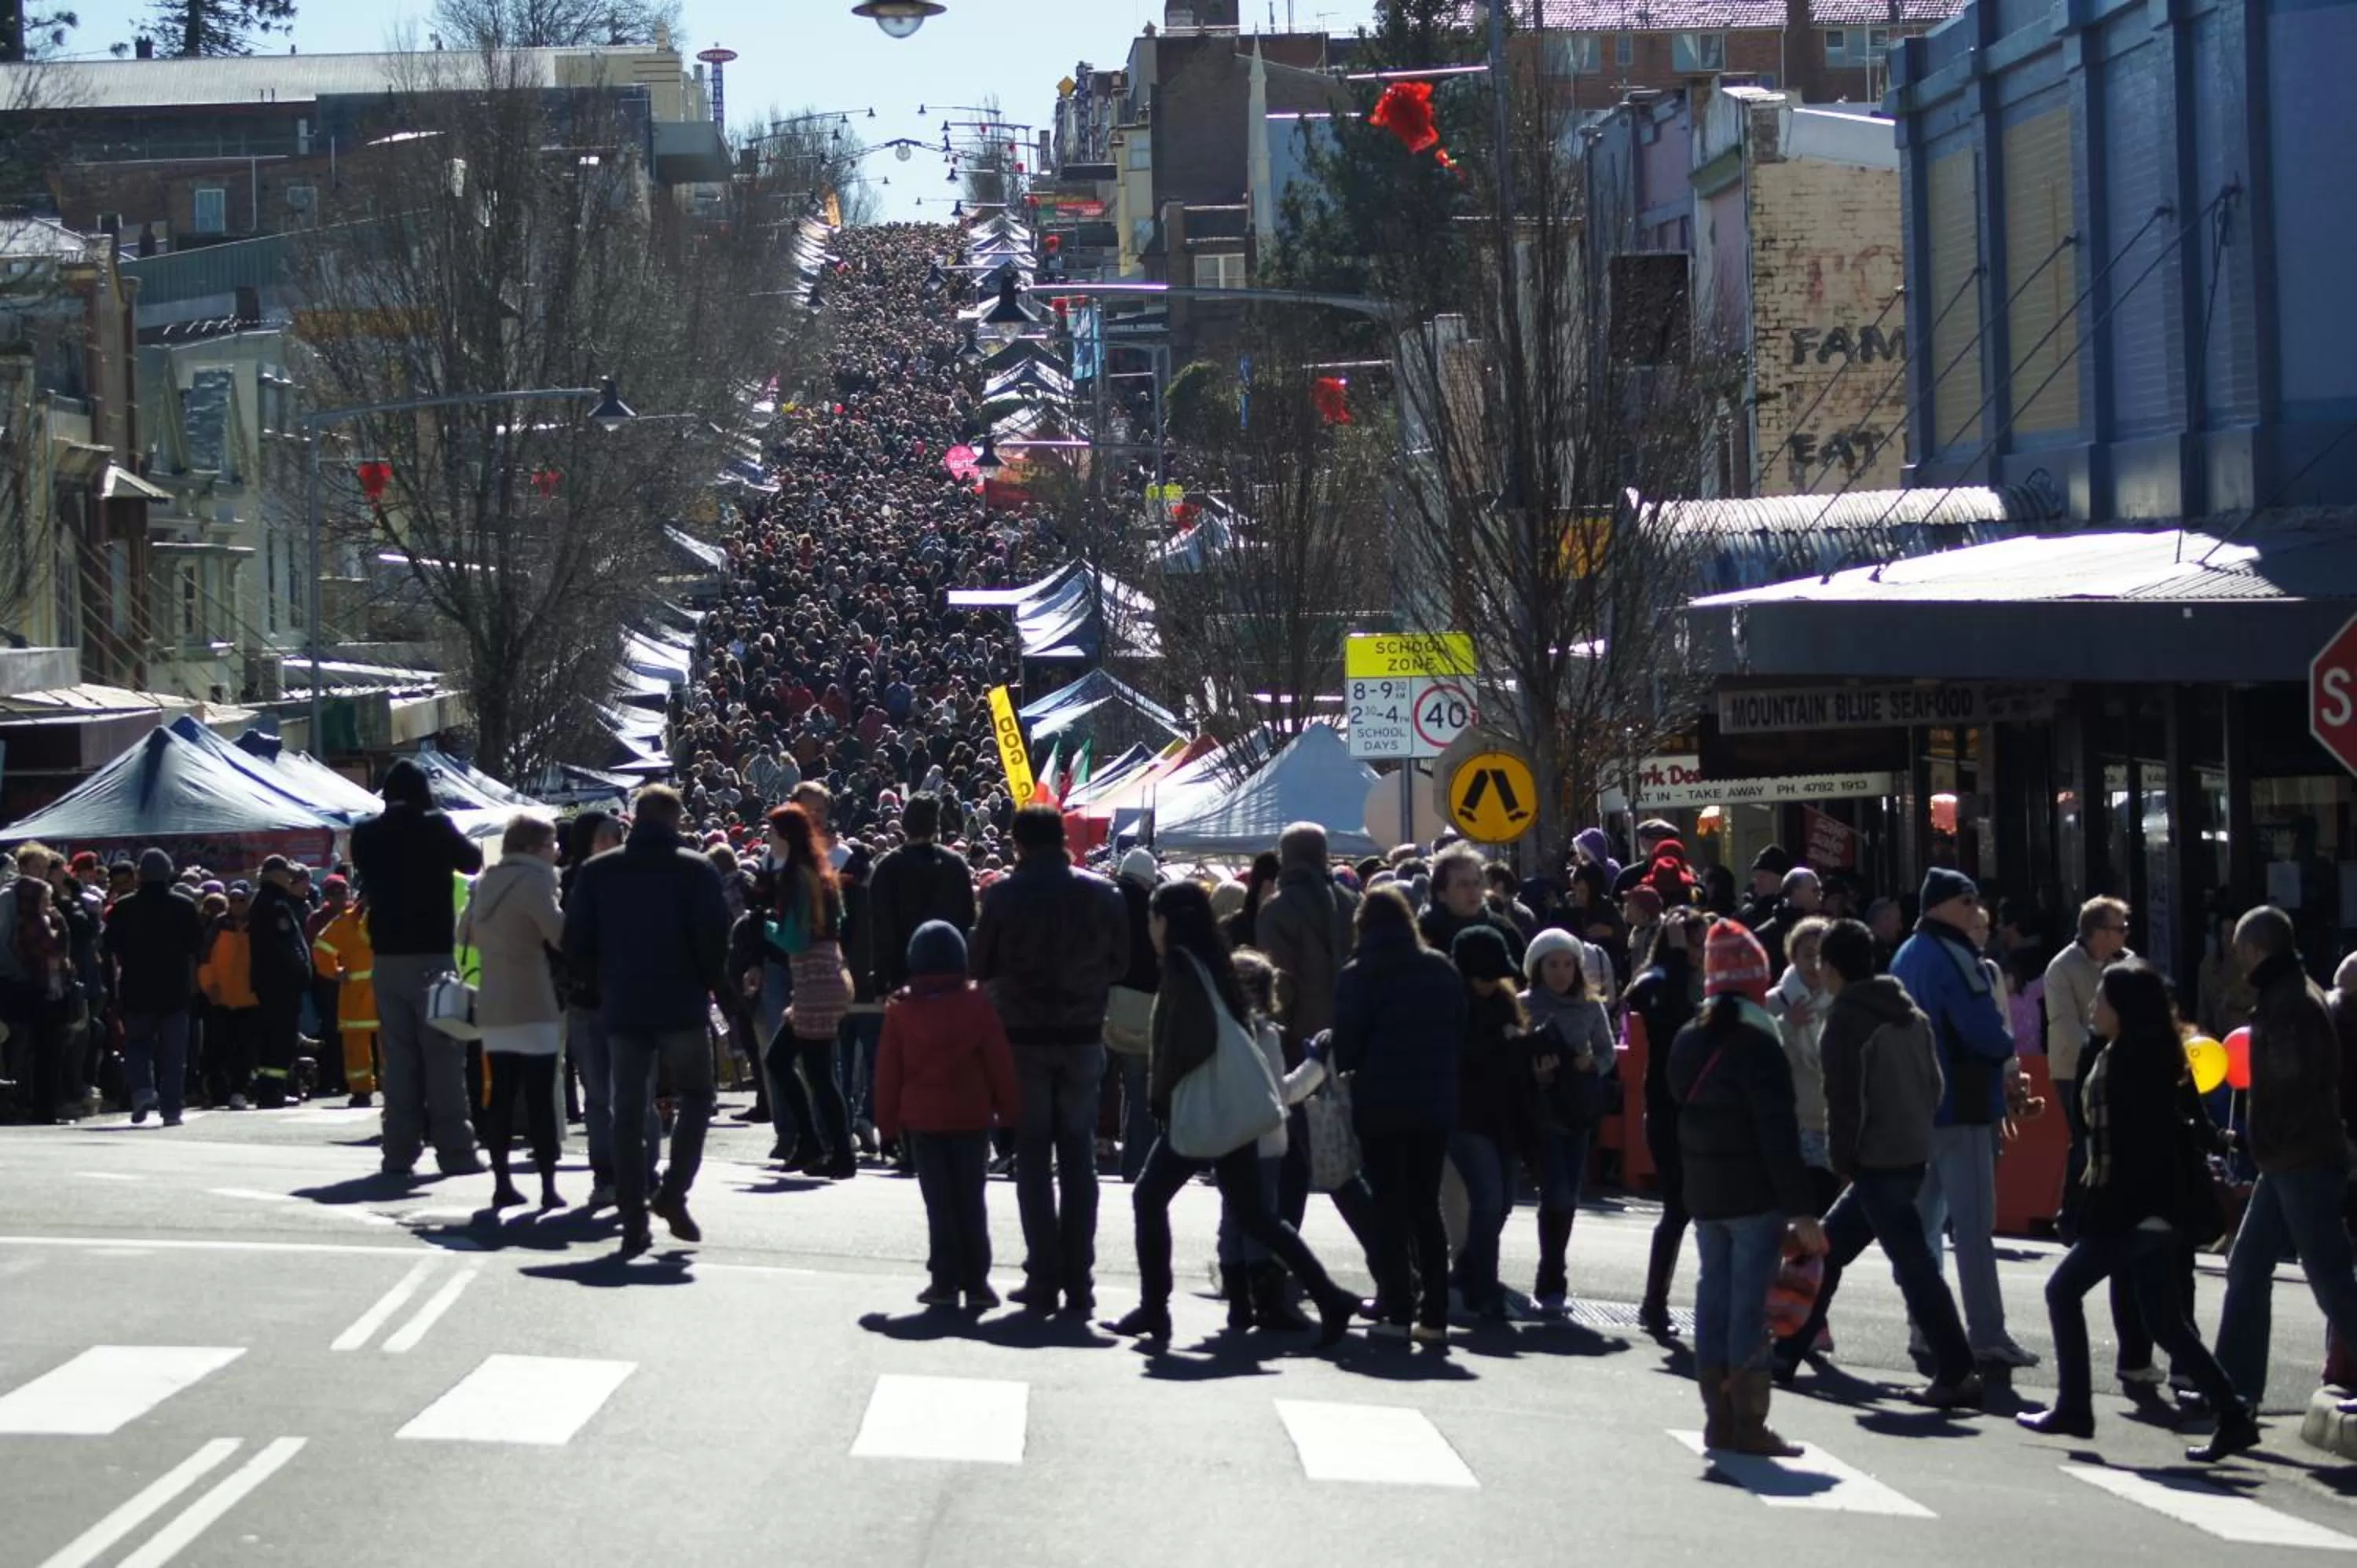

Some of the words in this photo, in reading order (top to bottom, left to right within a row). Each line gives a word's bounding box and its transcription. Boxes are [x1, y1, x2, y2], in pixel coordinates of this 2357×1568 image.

[1375, 640, 1445, 654] SCHOOL
[1387, 658, 1436, 672] ZONE
[2322, 666, 2352, 727] S
[1731, 693, 1827, 729] MOUNTAIN
[1835, 690, 1882, 723] BLUE
[1889, 685, 1974, 720] SEAFOOD
[1425, 702, 1468, 728] 40
[1357, 727, 1407, 738] SCHOOL
[1363, 740, 1398, 752] DAYS
[1634, 793, 1651, 802] AT
[1657, 791, 1670, 801] IN
[1688, 788, 1722, 800] TAKE
[1728, 786, 1765, 797] AWAY
